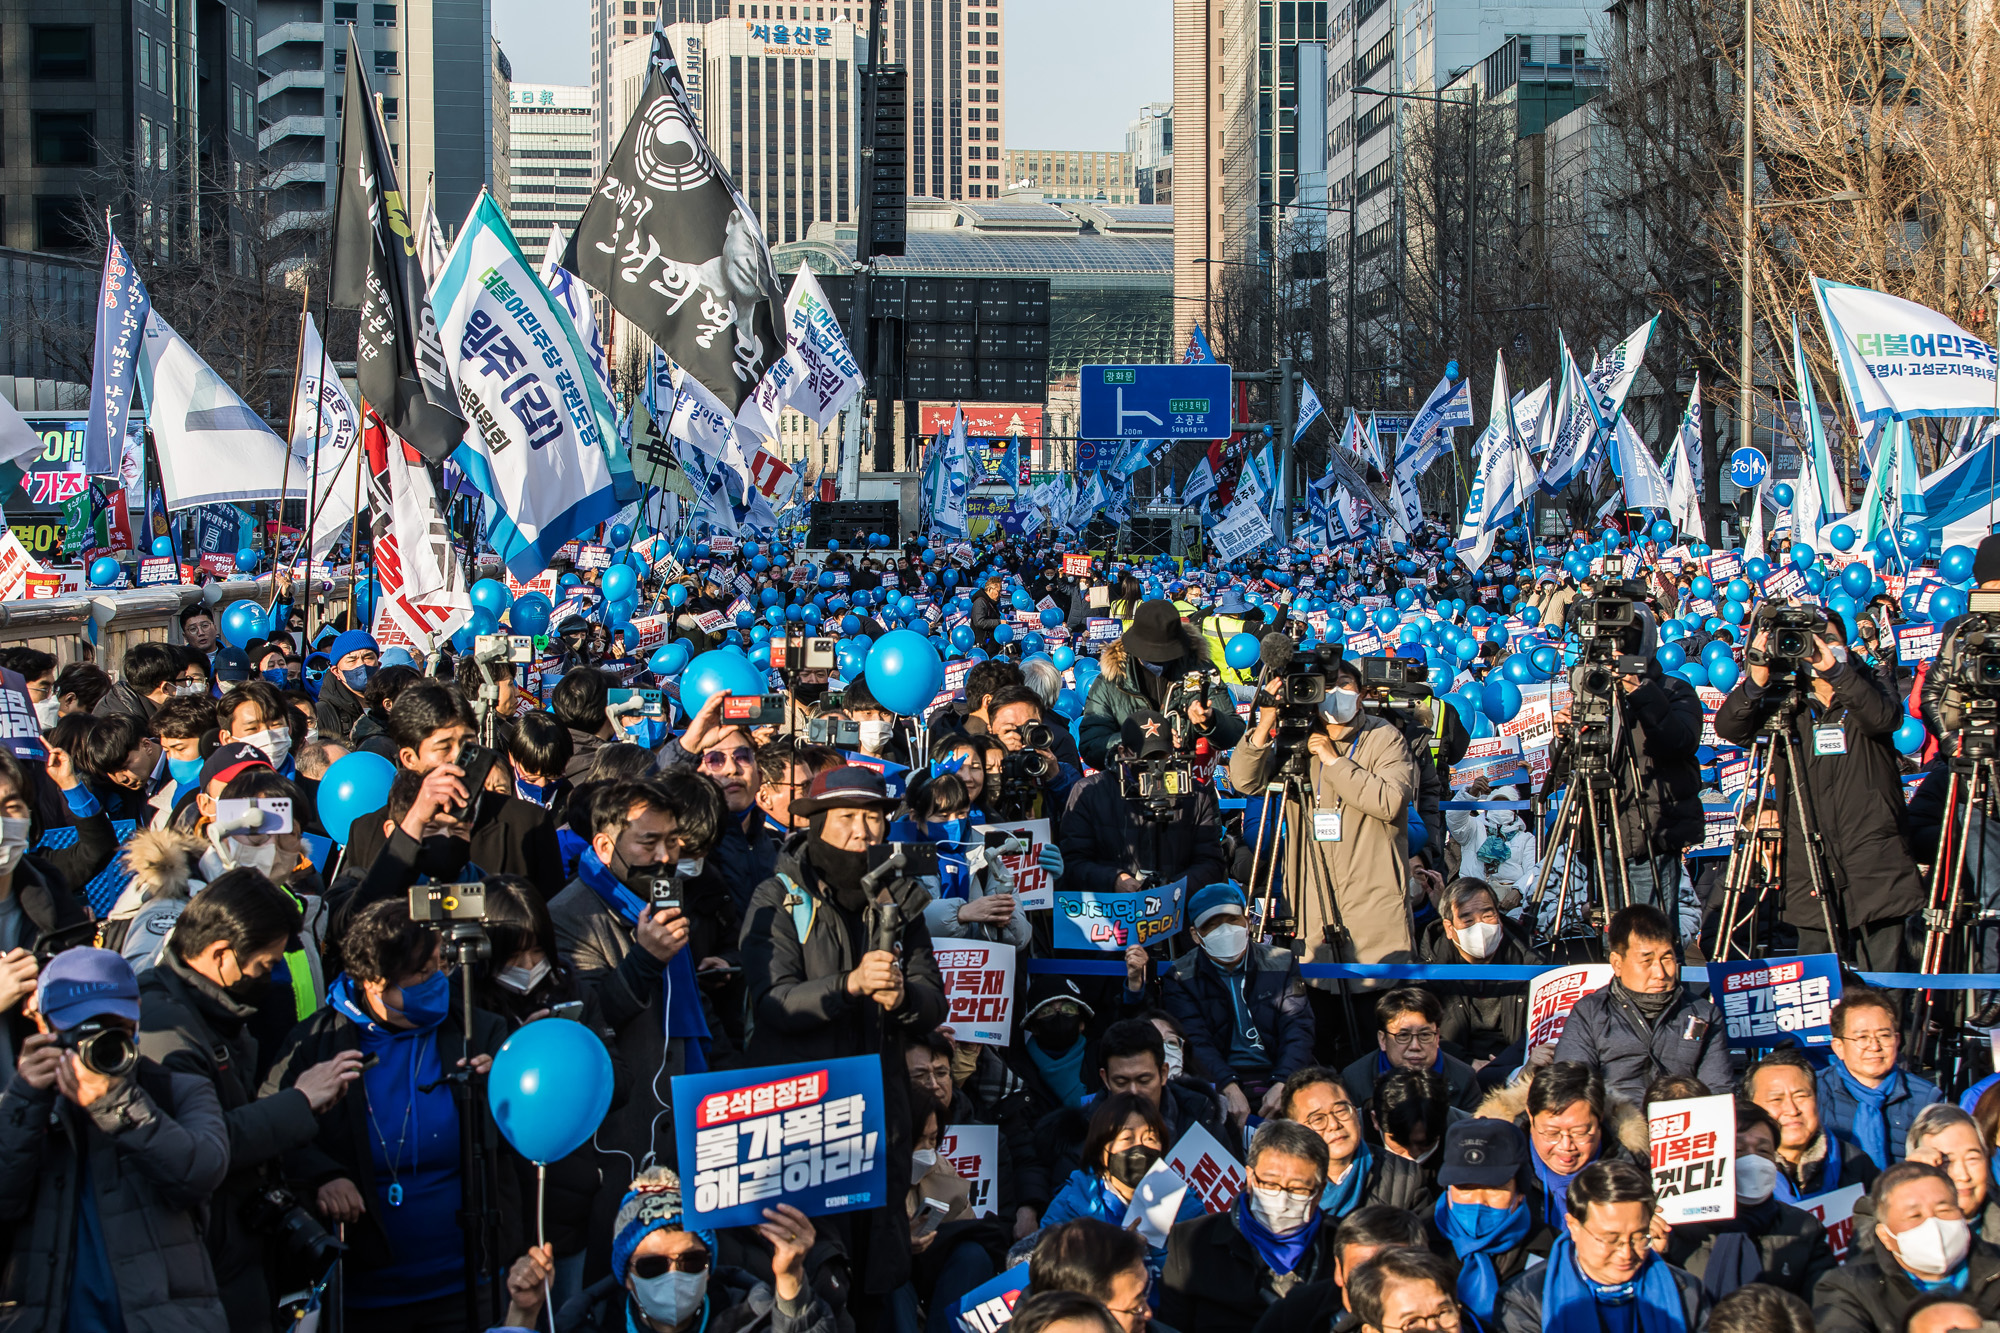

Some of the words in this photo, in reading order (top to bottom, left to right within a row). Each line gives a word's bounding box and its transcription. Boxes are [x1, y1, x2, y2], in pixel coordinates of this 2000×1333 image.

[752, 24, 832, 46] 서울신문
[478, 266, 564, 369] 더불어민주당
[460, 309, 565, 451] 원주(갑)
[1106, 371, 1133, 382] 광화문
[459, 378, 512, 456] 역위원회
[554, 367, 602, 447] 강원도당
[1173, 401, 1208, 411] 남산3호터널
[1175, 414, 1205, 426] 소공로
[1171, 425, 1208, 433] Sogong-ro
[33, 431, 83, 462] 아!
[1065, 557, 1088, 568] 윤석열
[1065, 566, 1088, 577] 퇴진!
[1585, 627, 1591, 635] 4
[1820, 741, 1841, 750] PRESS
[1091, 920, 1128, 946] 나는
[1136, 909, 1180, 943] 동지다!
[1535, 972, 1584, 1006] 윤석열정권
[1726, 963, 1799, 991] 윤석열정권
[947, 997, 1009, 1023] 한다!
[1723, 976, 1831, 1017] 물가폭탄
[705, 1074, 820, 1123] 윤석열정권
[696, 1094, 866, 1172] 물가폭탄
[694, 1131, 878, 1213] 해결하라!
[825, 1192, 871, 1208] 더불어민주당
